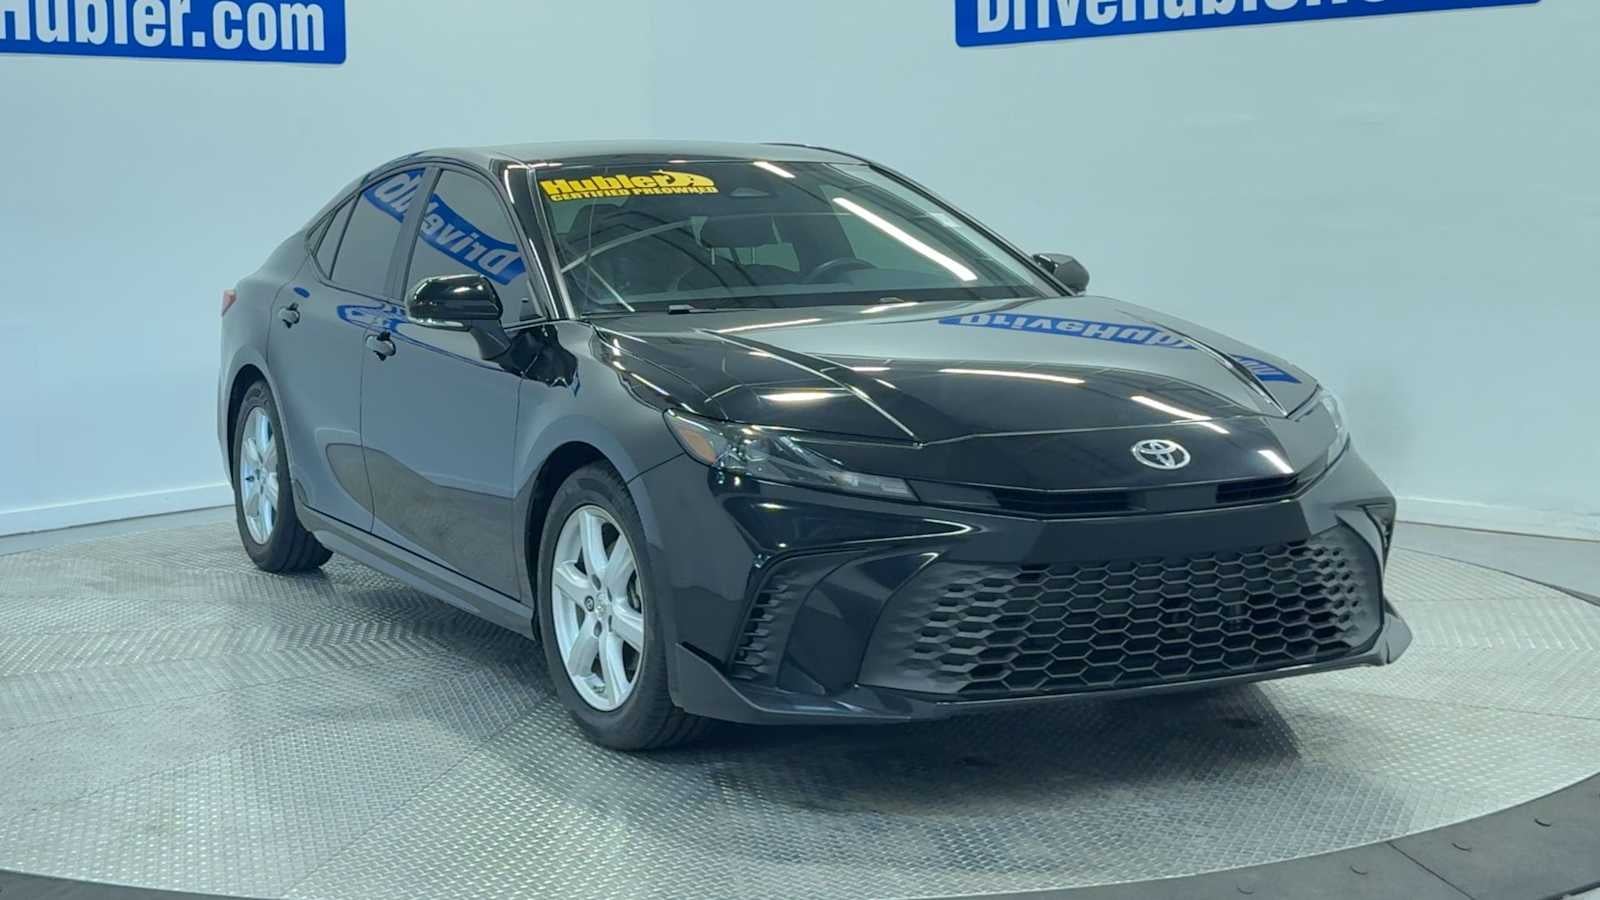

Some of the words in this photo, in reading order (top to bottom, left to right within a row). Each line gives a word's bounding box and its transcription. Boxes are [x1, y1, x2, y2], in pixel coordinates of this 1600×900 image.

[540, 174, 677, 195] Hubler
[551, 189, 630, 201] CERTIFIED
[634, 187, 719, 196] PREOWNED
